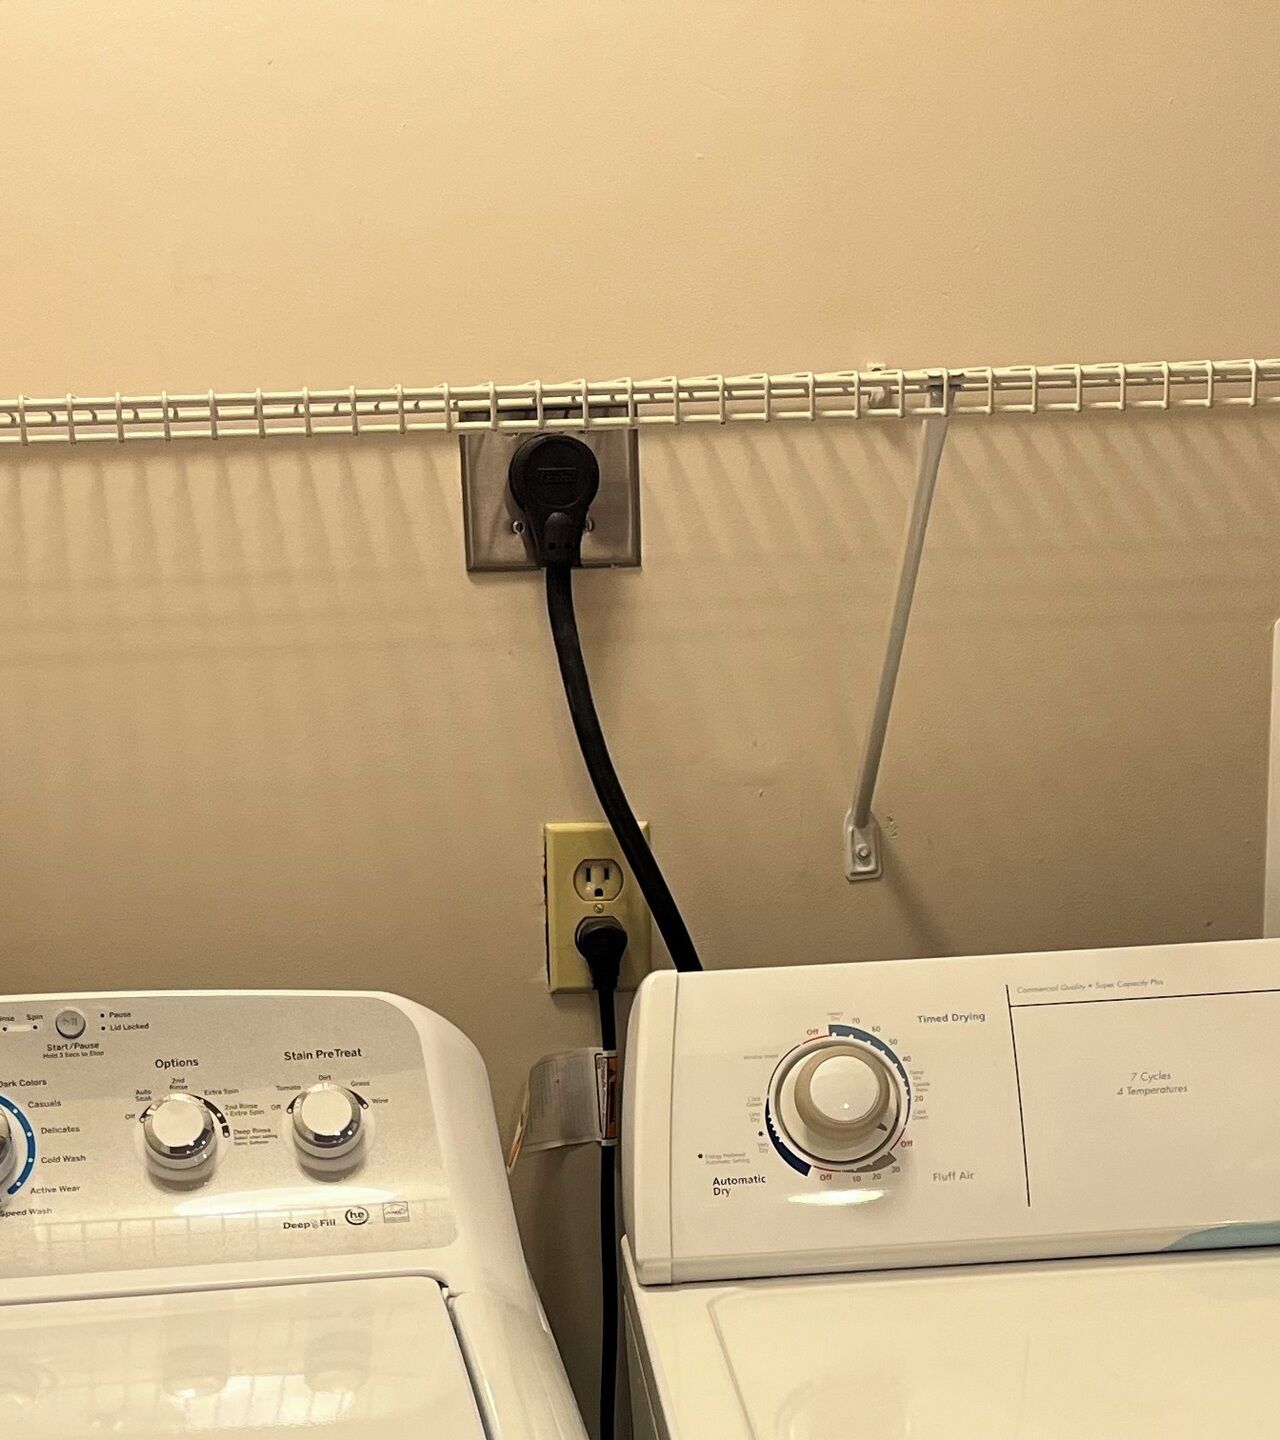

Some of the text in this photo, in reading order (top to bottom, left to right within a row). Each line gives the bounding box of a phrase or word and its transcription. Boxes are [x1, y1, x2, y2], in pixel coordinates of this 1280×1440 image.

[1060, 984, 1086, 992] Quality
[1094, 982, 1114, 990] Super
[1116, 980, 1148, 988] Capacity
[851, 1017, 861, 1025] 70
[917, 1012, 986, 1024] Timed Drying
[123, 1022, 150, 1031] Locked
[806, 1028, 819, 1036] Off
[46, 1042, 100, 1052] Start/Pause
[888, 1038, 898, 1046] 50
[284, 1048, 363, 1062] Stain PreTreat
[902, 1055, 912, 1063] 40
[154, 1058, 200, 1070] Options
[1130, 1070, 1172, 1083] 7 Cycles
[18, 1079, 48, 1087] Colors
[1116, 1086, 1188, 1097] 4 Temperatures
[914, 1095, 924, 1103] 20
[28, 1100, 62, 1109] Casuals
[40, 1125, 81, 1135] Delicates
[900, 1140, 913, 1148] Off
[40, 1154, 86, 1164] Cold Wash
[712, 1174, 767, 1186] Automatic
[820, 1174, 832, 1182] Off
[932, 1170, 975, 1182] Fluff Air
[30, 1184, 81, 1195] Active Wear
[713, 1187, 732, 1197] Dry
[28, 1207, 53, 1216] Wash
[282, 1218, 336, 1230] Deep Fill
